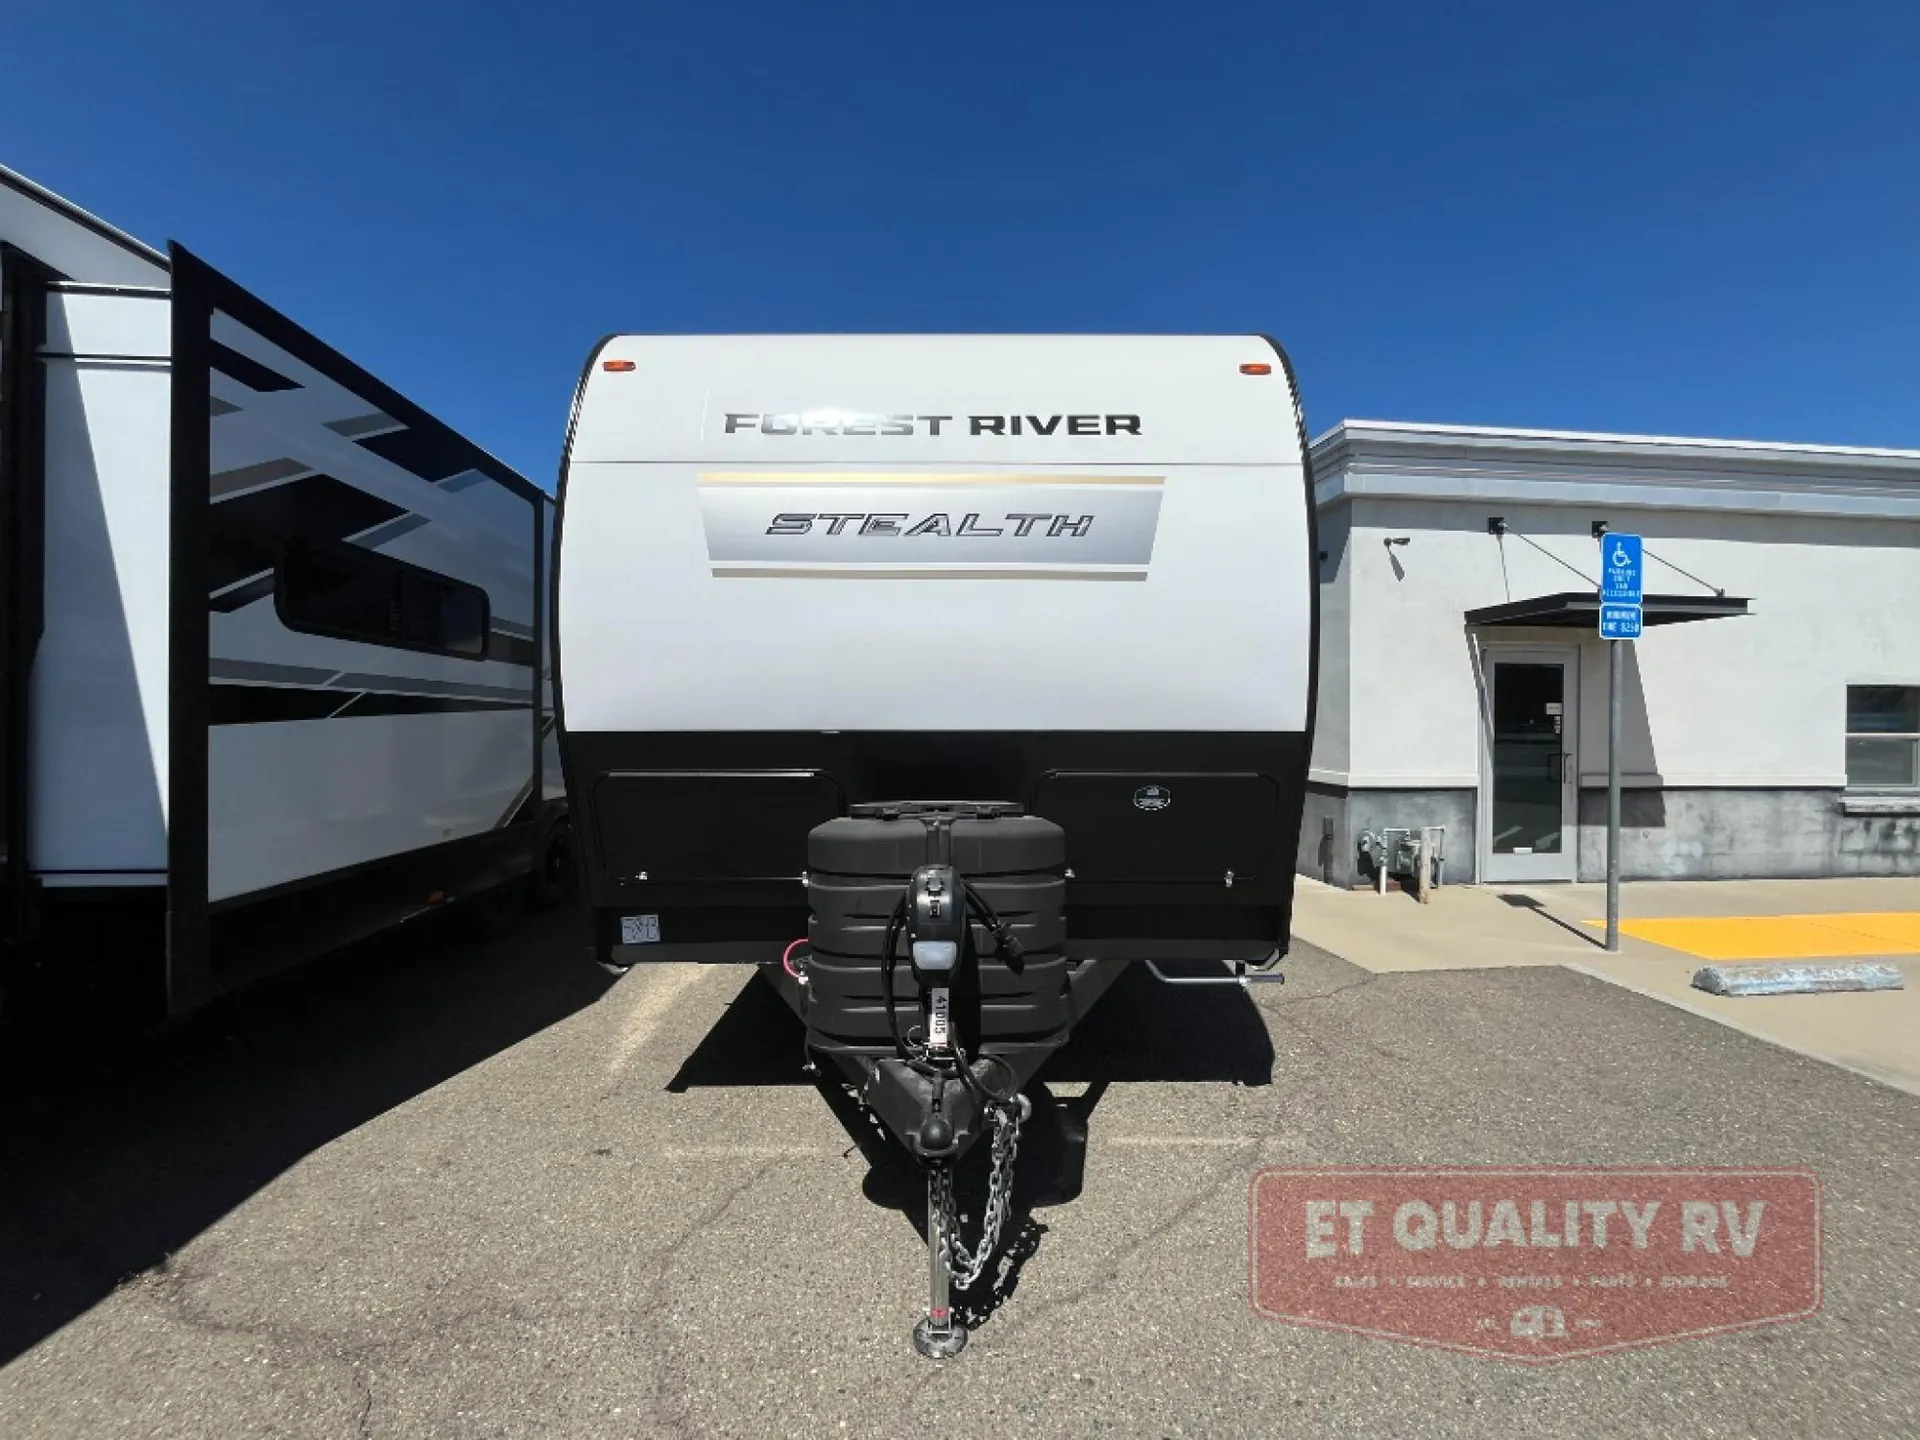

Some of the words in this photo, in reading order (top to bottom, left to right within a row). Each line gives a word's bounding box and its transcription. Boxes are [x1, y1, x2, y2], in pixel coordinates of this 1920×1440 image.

[724, 413, 953, 436] FOREST
[968, 413, 1143, 436] RIVER
[765, 513, 1094, 537] STEALTH
